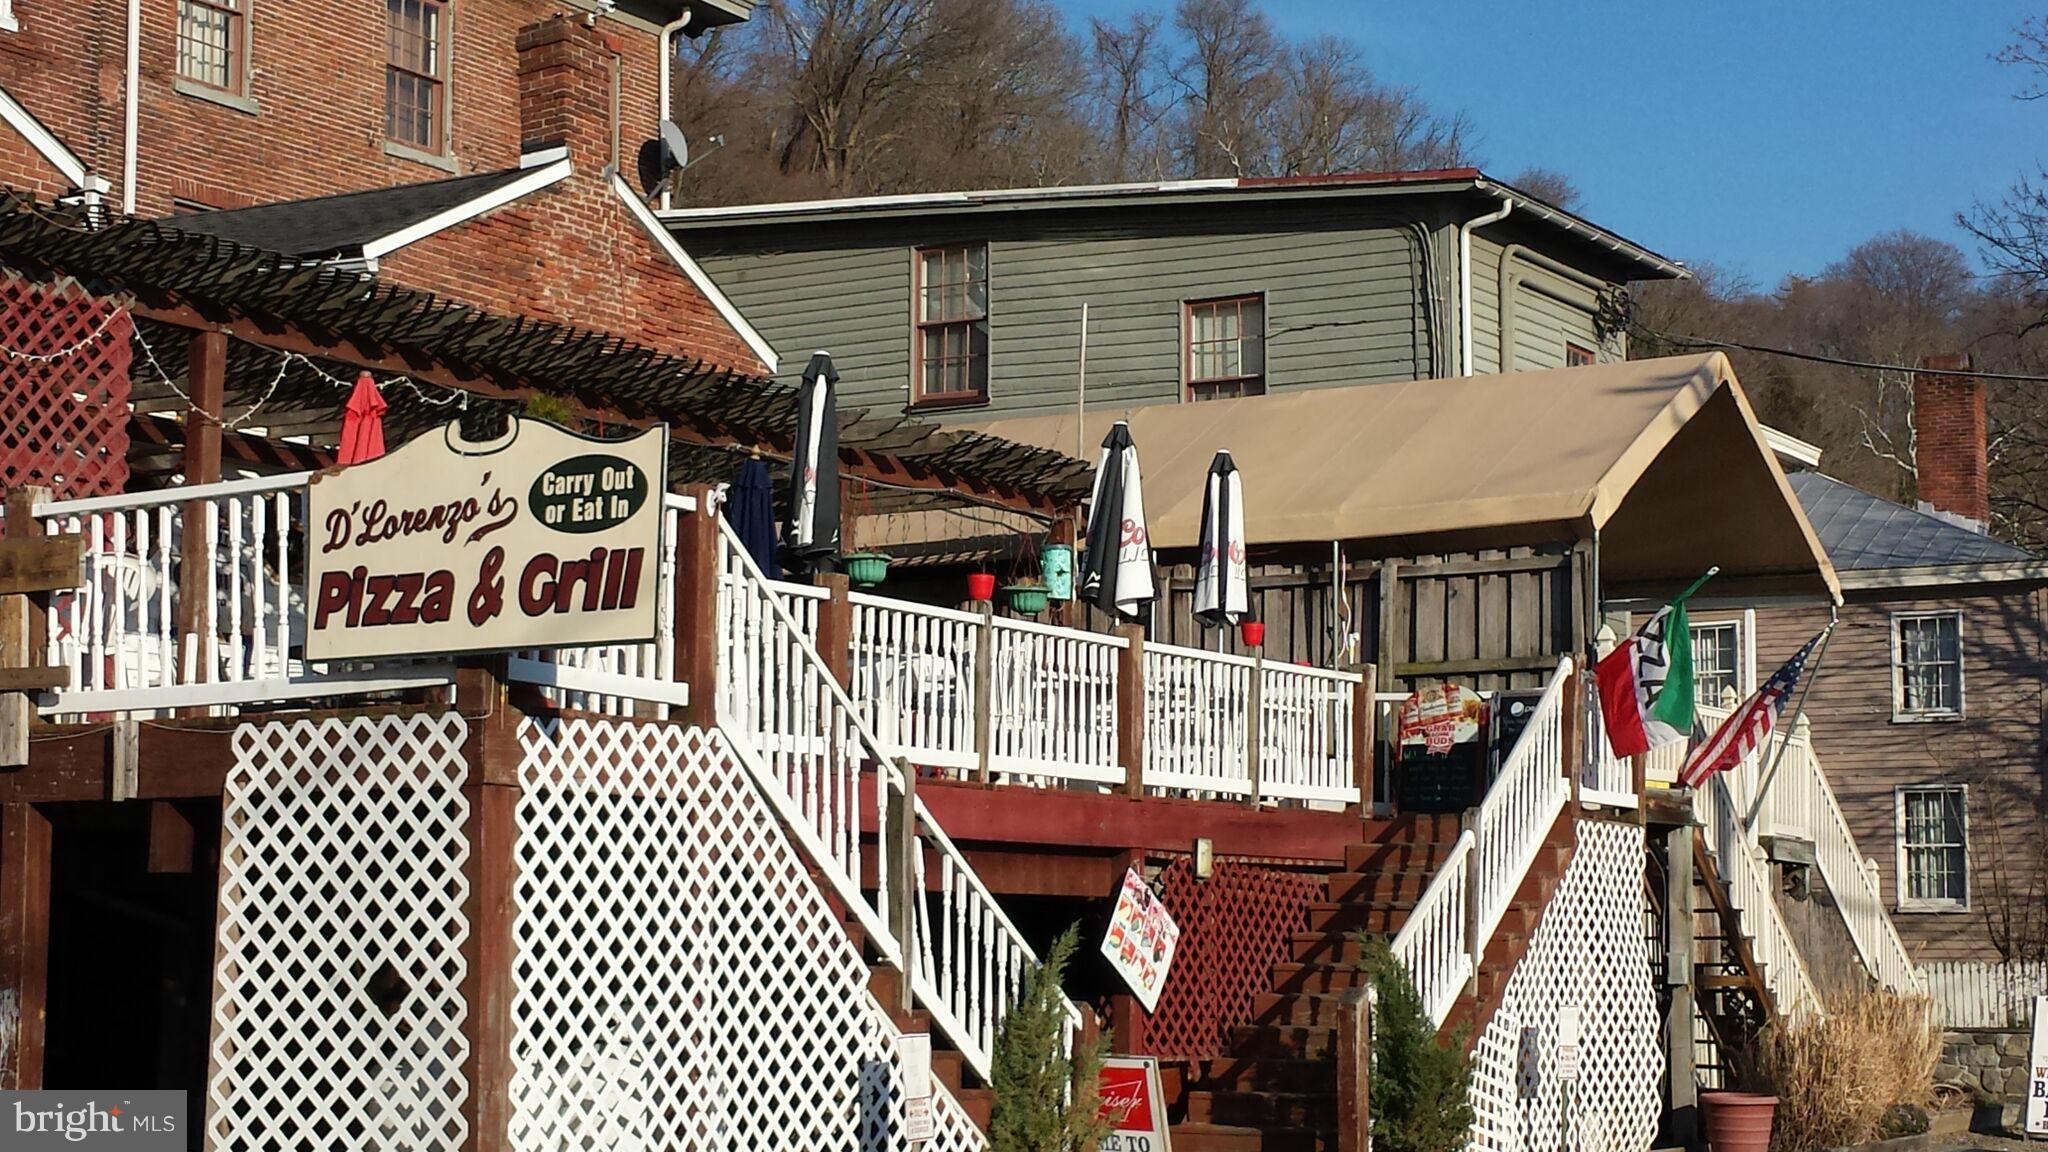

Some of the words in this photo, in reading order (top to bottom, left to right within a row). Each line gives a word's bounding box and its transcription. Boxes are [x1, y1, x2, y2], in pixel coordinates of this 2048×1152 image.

[542, 472, 595, 498] Carry
[601, 466, 635, 491] Out
[322, 471, 518, 553] D'Lorenzo's
[545, 504, 566, 524] or
[572, 497, 604, 522] Eat
[611, 494, 630, 520] In
[313, 565, 456, 630] Pizza
[467, 545, 506, 628] &
[518, 547, 646, 618] Grill
[1425, 724, 1456, 732] GRAB
[1425, 737, 1455, 745] BUDS
[1126, 1136, 1150, 1152] TO
